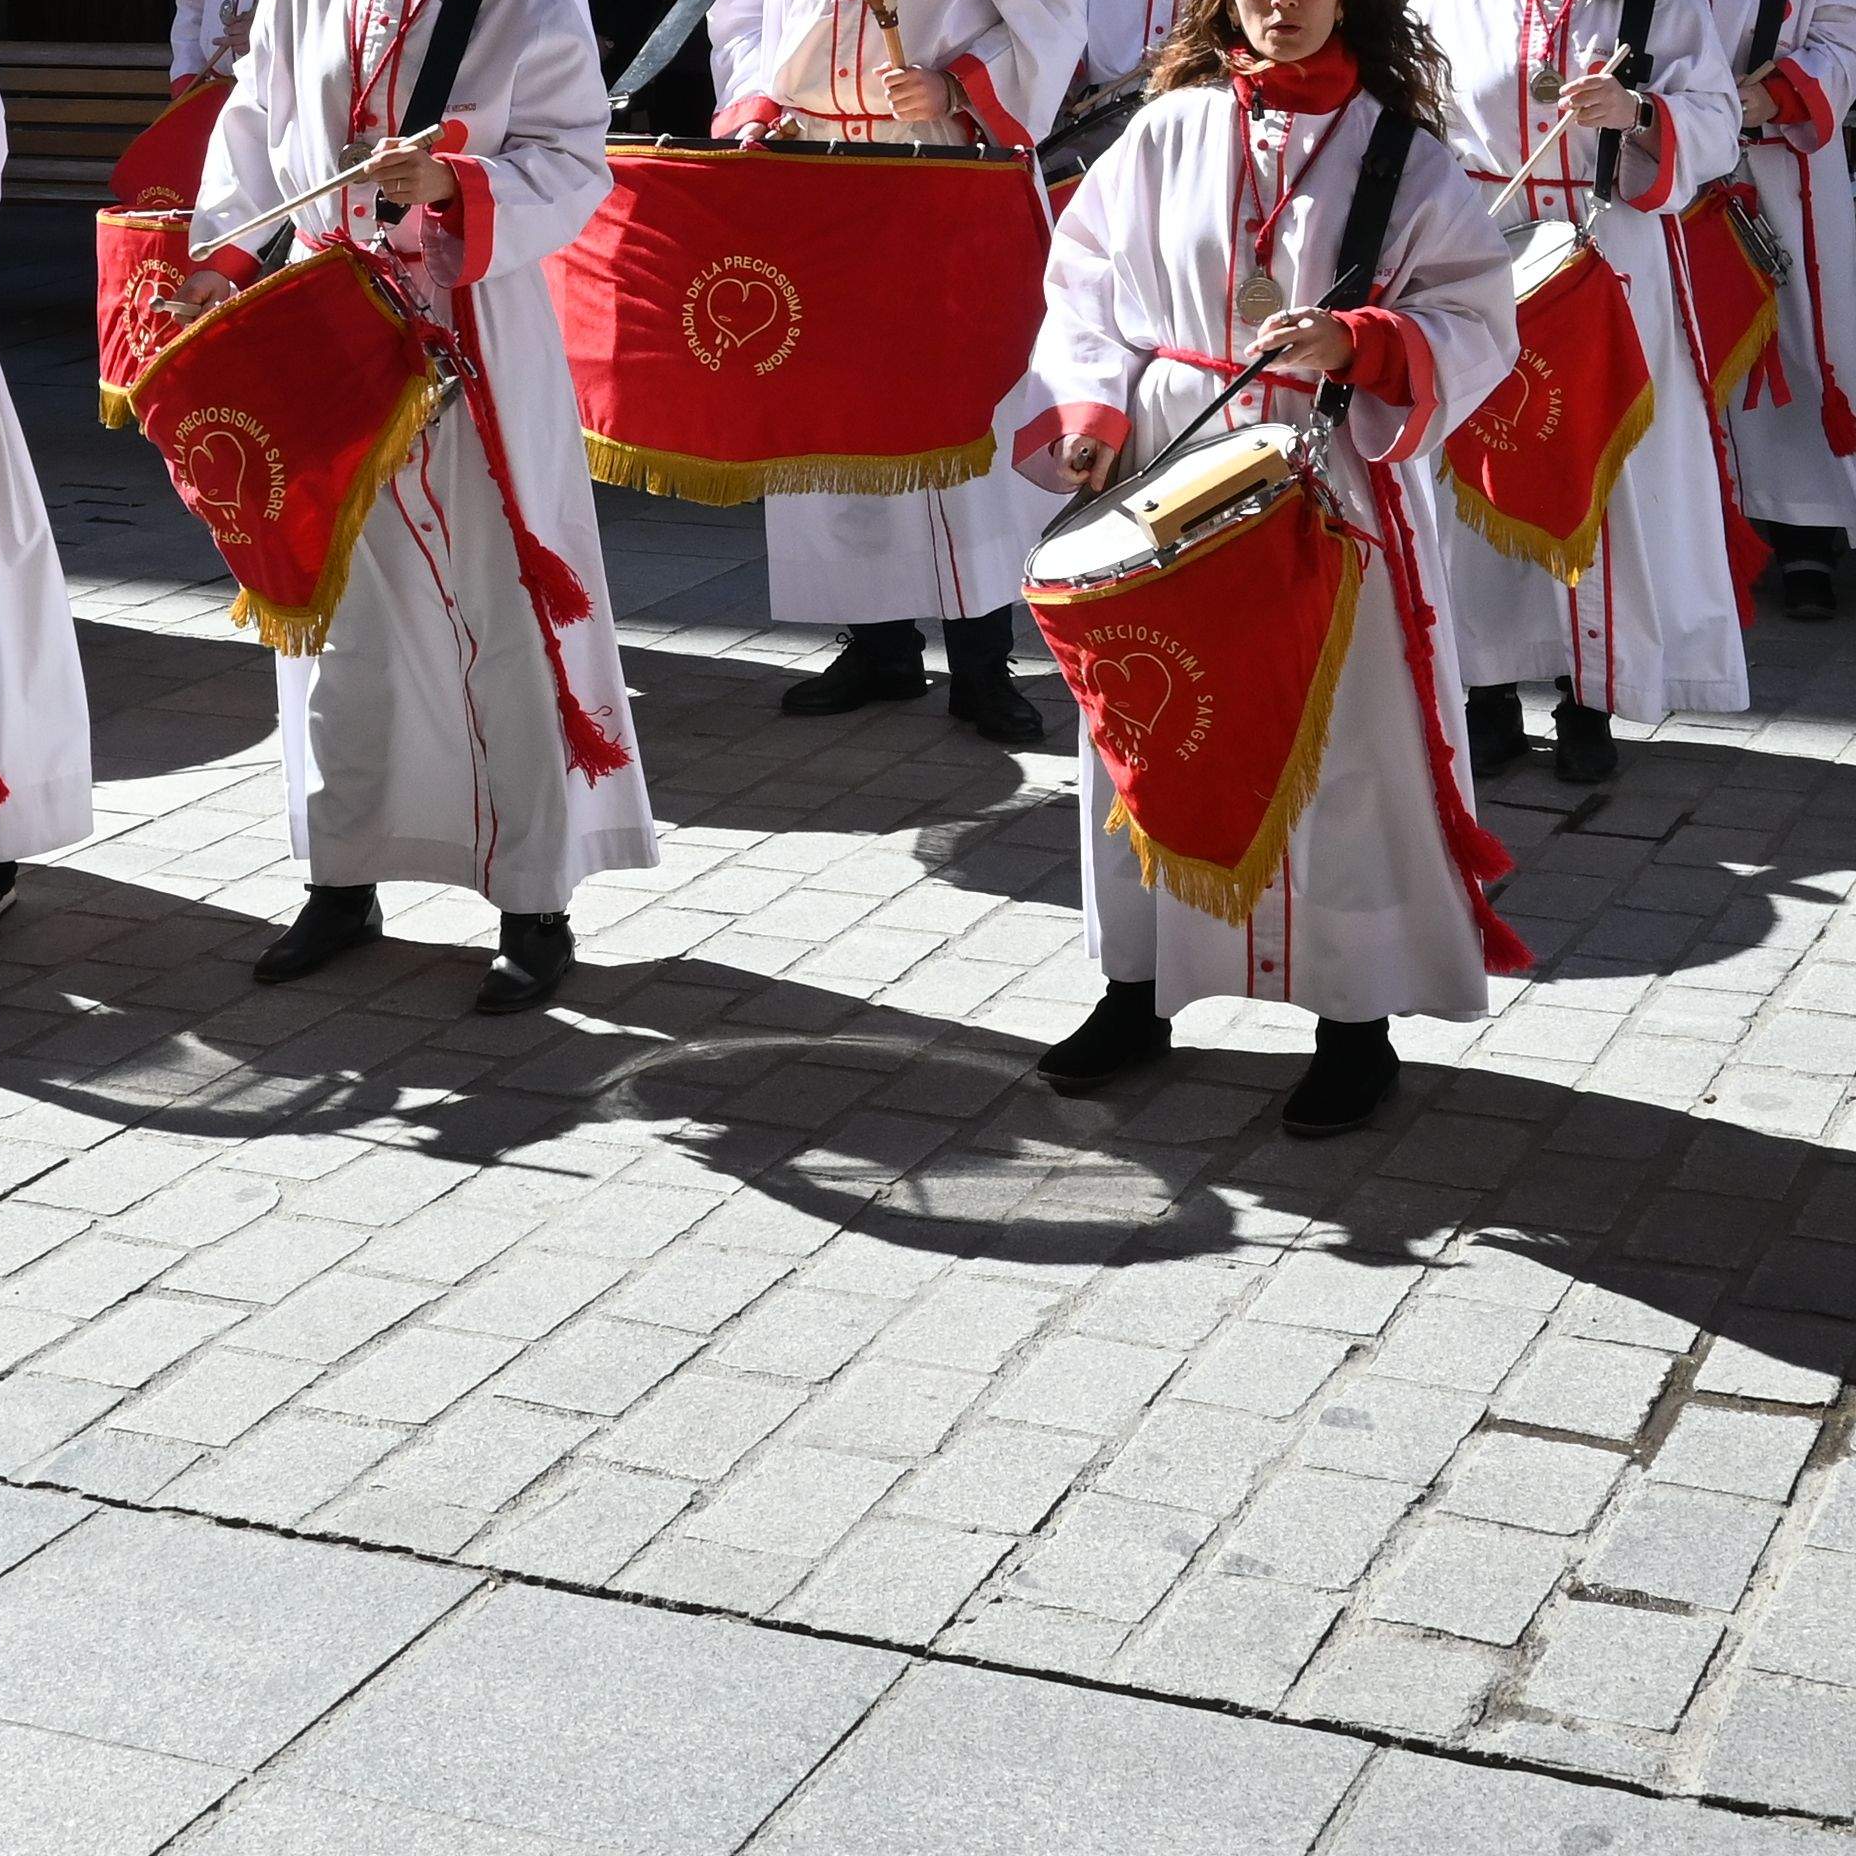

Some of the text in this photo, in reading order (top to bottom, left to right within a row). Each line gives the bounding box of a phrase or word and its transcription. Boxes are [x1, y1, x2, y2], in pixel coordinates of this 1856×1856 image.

[142, 259, 186, 286] PRECIOS
[682, 255, 803, 376] COFRADIA DE LA PRECIOSISIMA SANGRE
[175, 407, 271, 448] PRECIOSISIMA
[1468, 387, 1562, 452] COFRAD SANGRE
[173, 443, 185, 465] LA
[264, 448, 286, 522] SANGRE
[1084, 624, 1206, 682] PRECIOSISIMA
[1175, 694, 1214, 761] SANGRE
